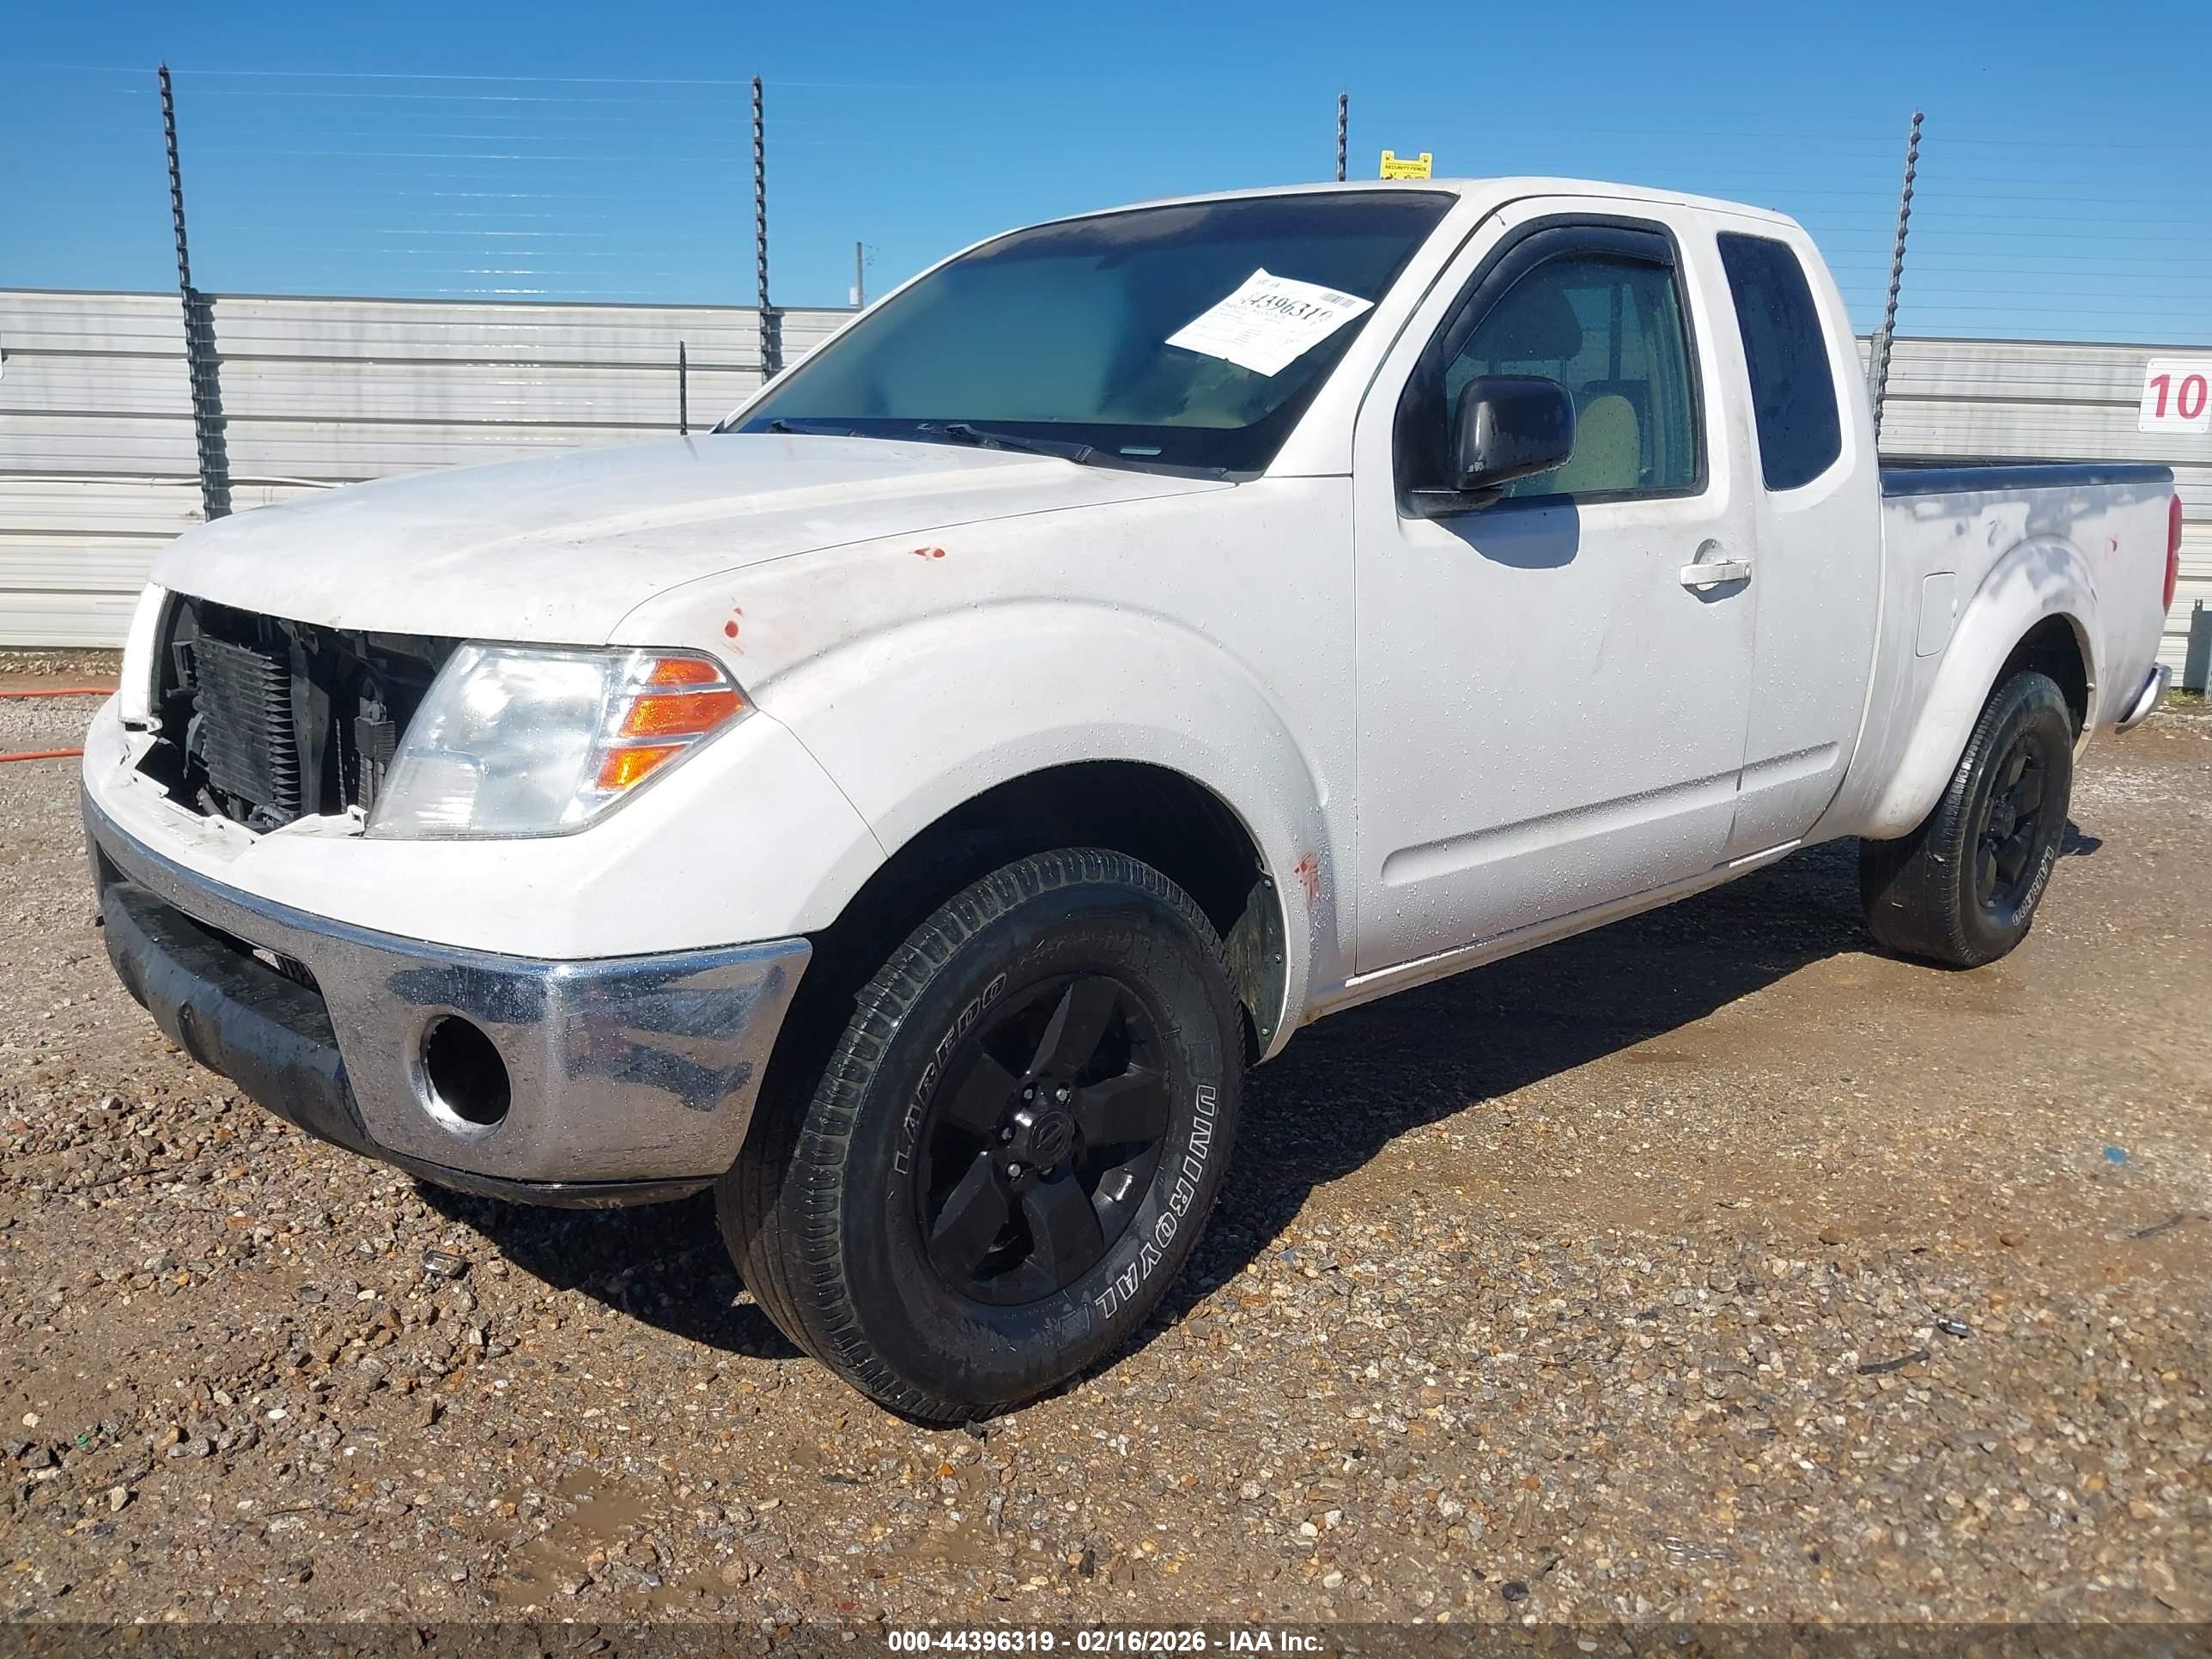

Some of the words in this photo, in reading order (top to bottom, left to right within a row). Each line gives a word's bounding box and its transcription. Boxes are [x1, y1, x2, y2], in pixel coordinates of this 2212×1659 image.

[2150, 374, 2208, 419] 10
[2012, 845, 2054, 927] LAREDO
[894, 972, 1006, 1175] LAREDO
[1094, 1084, 1216, 1319] UNIROYAL
